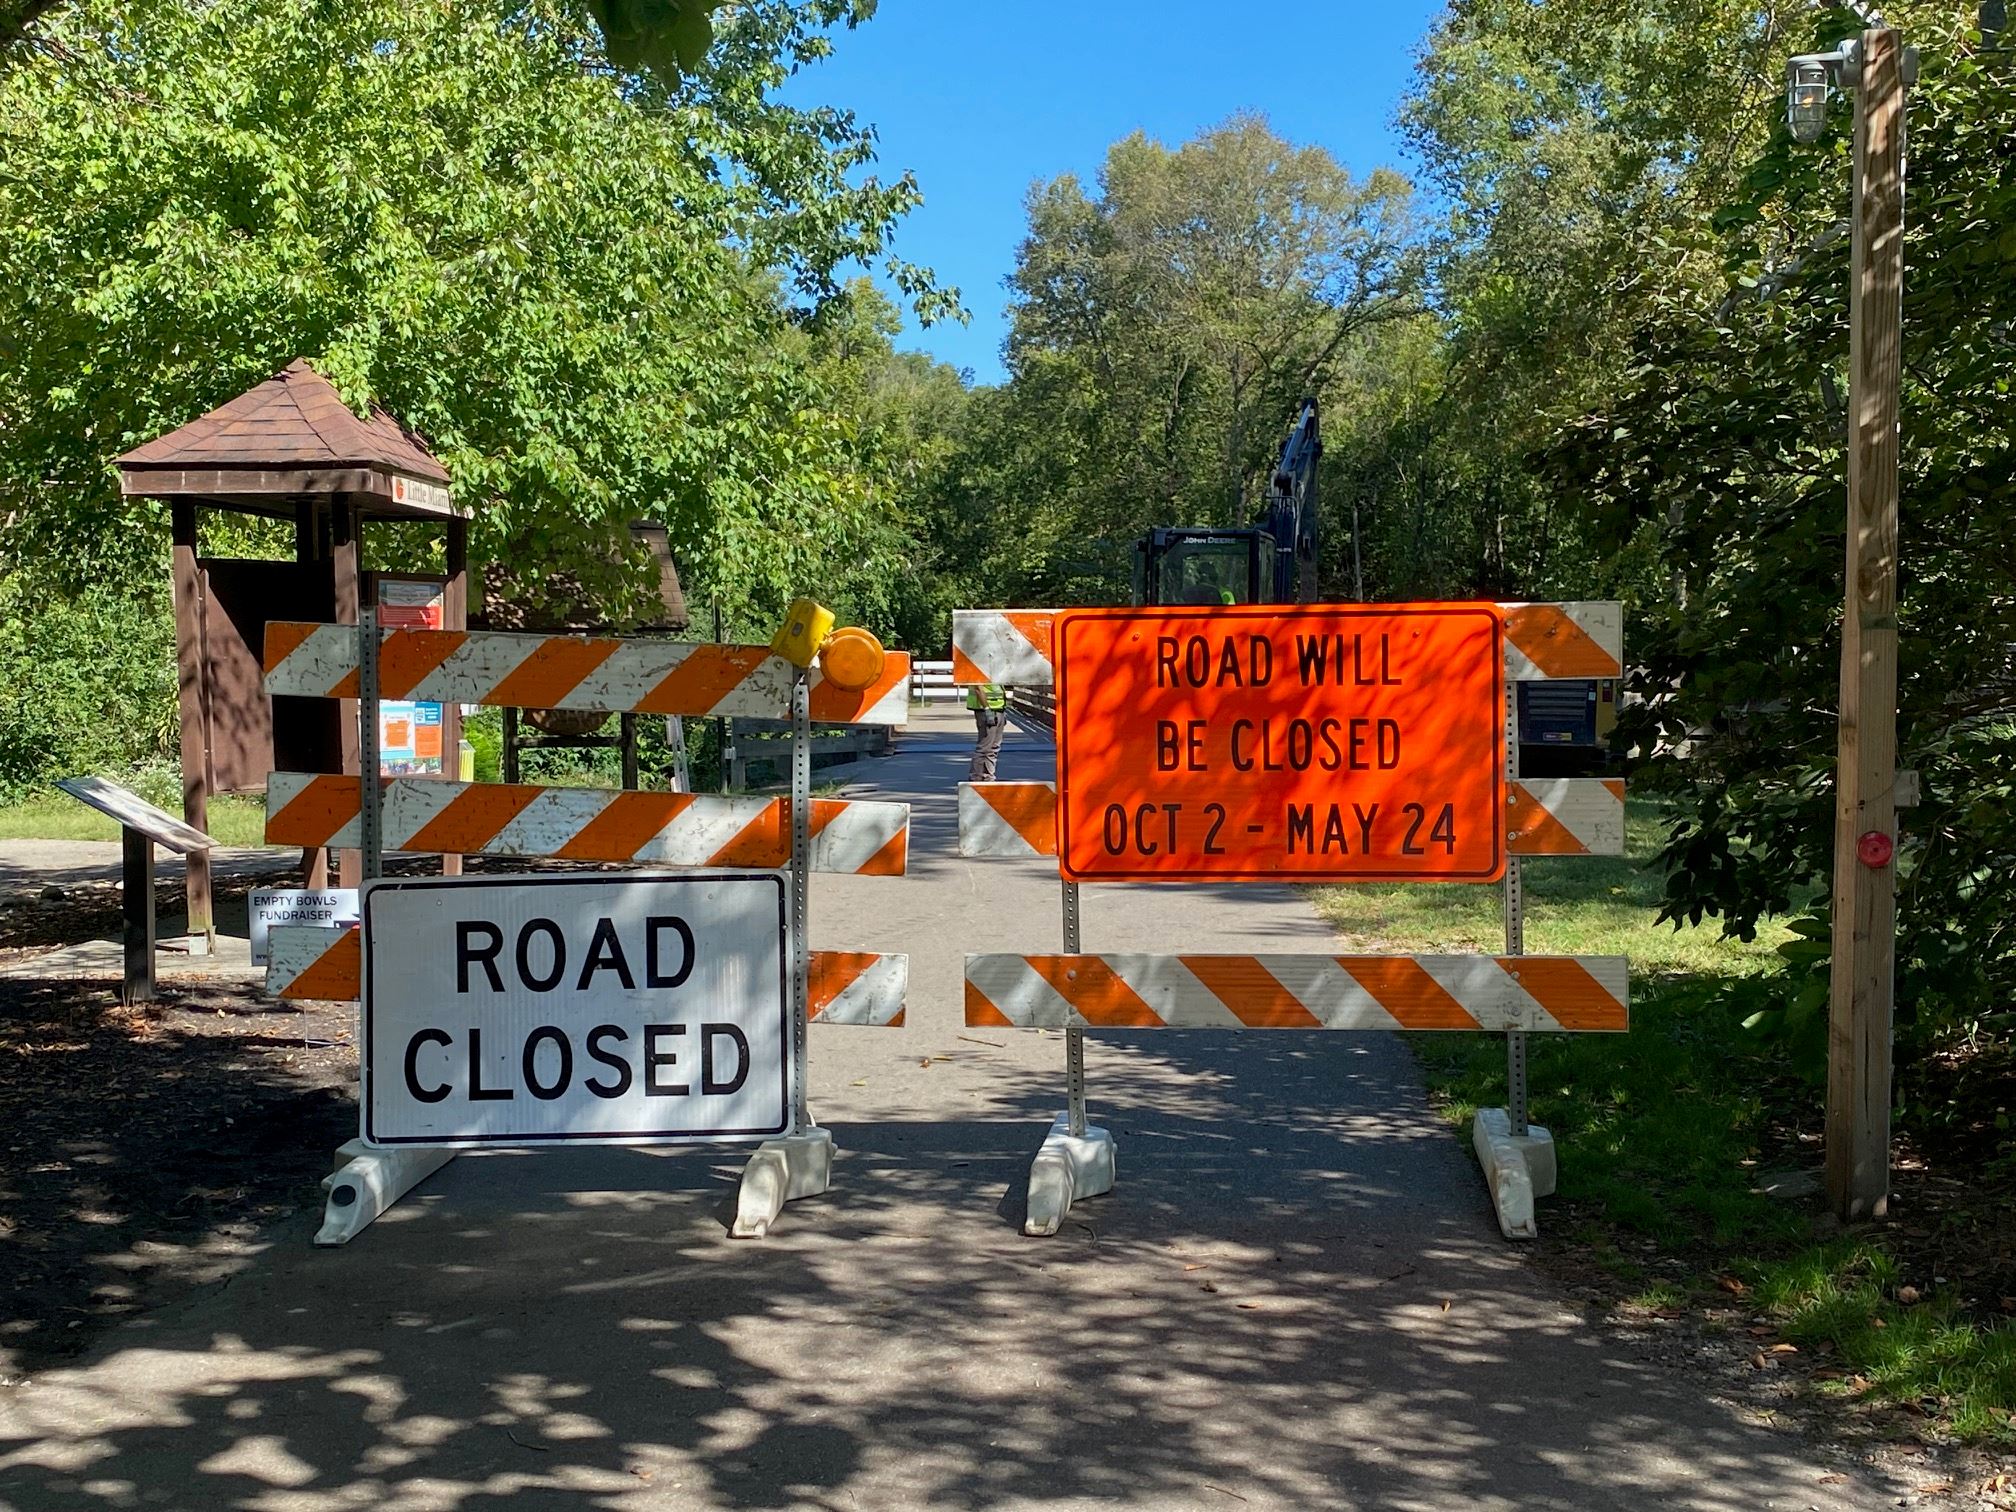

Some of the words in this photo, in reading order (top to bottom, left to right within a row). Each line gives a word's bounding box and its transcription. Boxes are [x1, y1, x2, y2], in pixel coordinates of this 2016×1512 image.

[407, 480, 427, 503] Little
[428, 485, 448, 508] Miam
[1157, 634, 1273, 689] ROAD
[1296, 633, 1402, 687] WILL
[1157, 719, 1208, 773] BE
[1231, 718, 1401, 772] CLOSED
[1103, 803, 1182, 856] OCT
[1202, 803, 1227, 855] 2
[1287, 803, 1380, 855] MAY
[1401, 802, 1456, 855] 24
[254, 896, 294, 906] EMPTY
[296, 896, 337, 906] BOWLS
[260, 910, 333, 920] FUNDRAISER
[456, 916, 696, 994] ROAD
[404, 1022, 750, 1104] CLOSED
